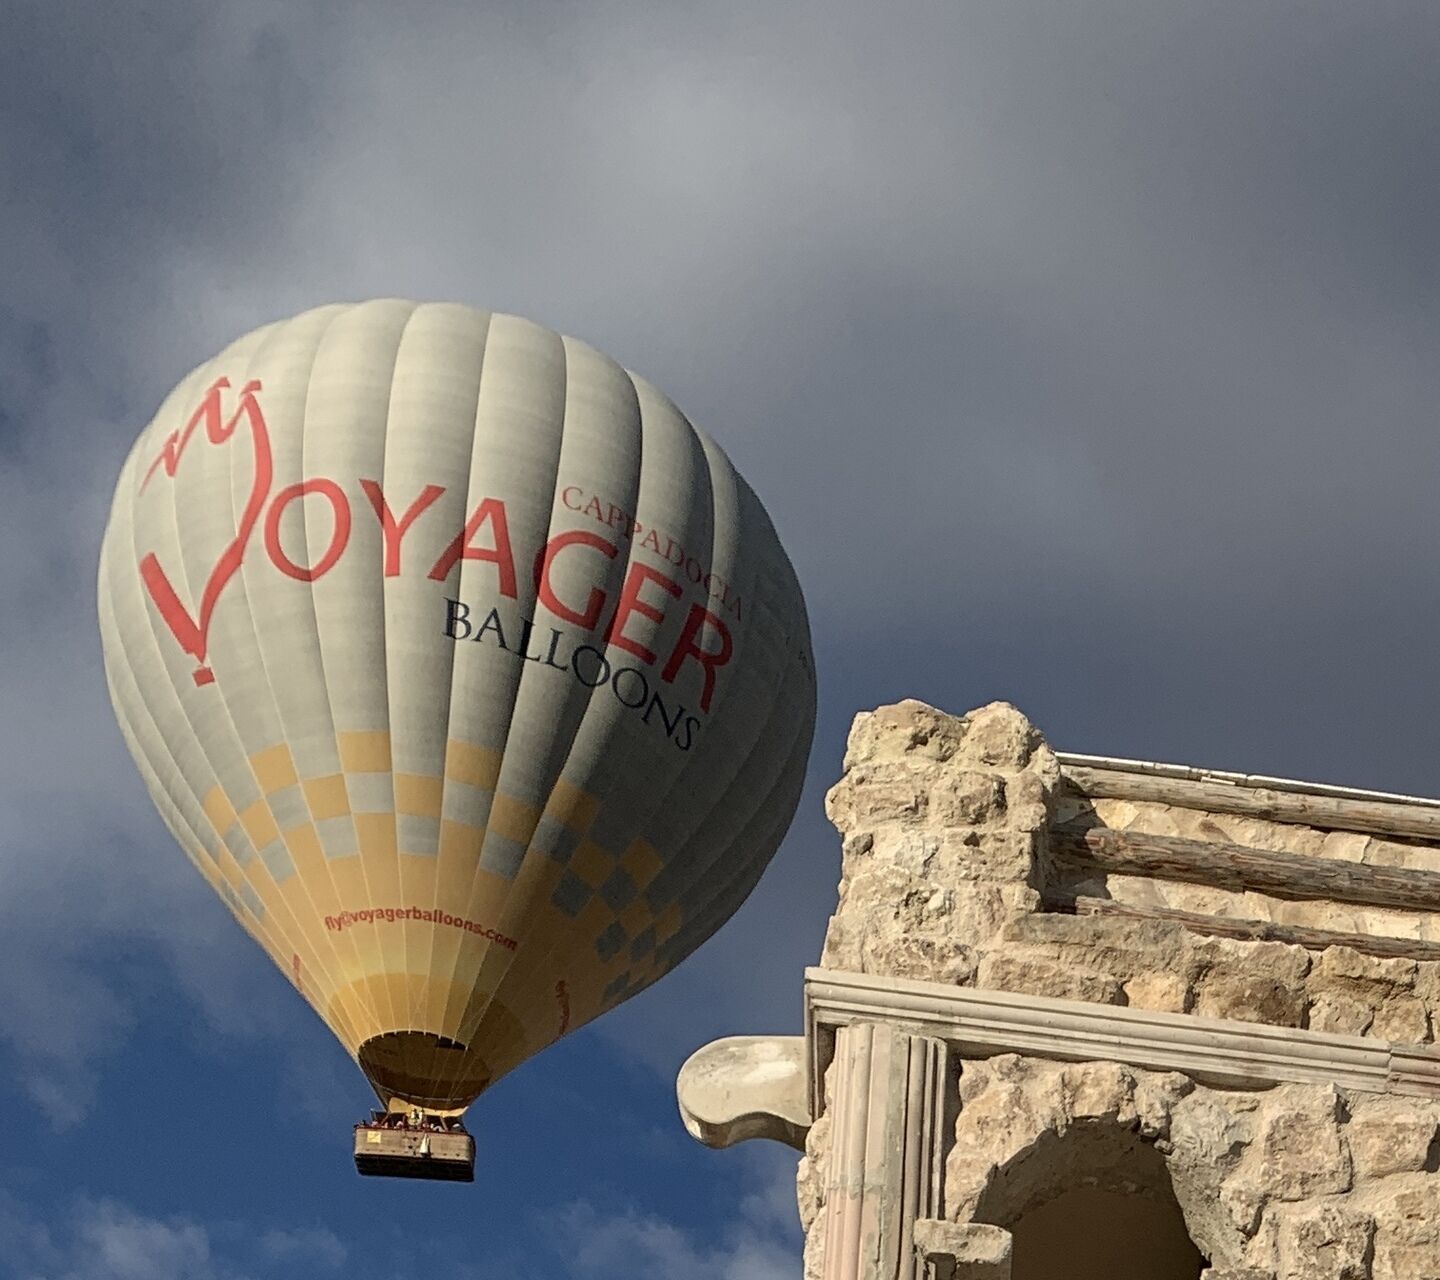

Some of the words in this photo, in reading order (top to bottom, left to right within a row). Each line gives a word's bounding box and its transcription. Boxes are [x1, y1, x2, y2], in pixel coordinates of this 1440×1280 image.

[139, 376, 734, 714] VOYAGER
[562, 486, 743, 622] CAPPADOCIA
[442, 597, 701, 751] BALLOONS
[324, 906, 519, 951] fly@voyagerballoons.com
